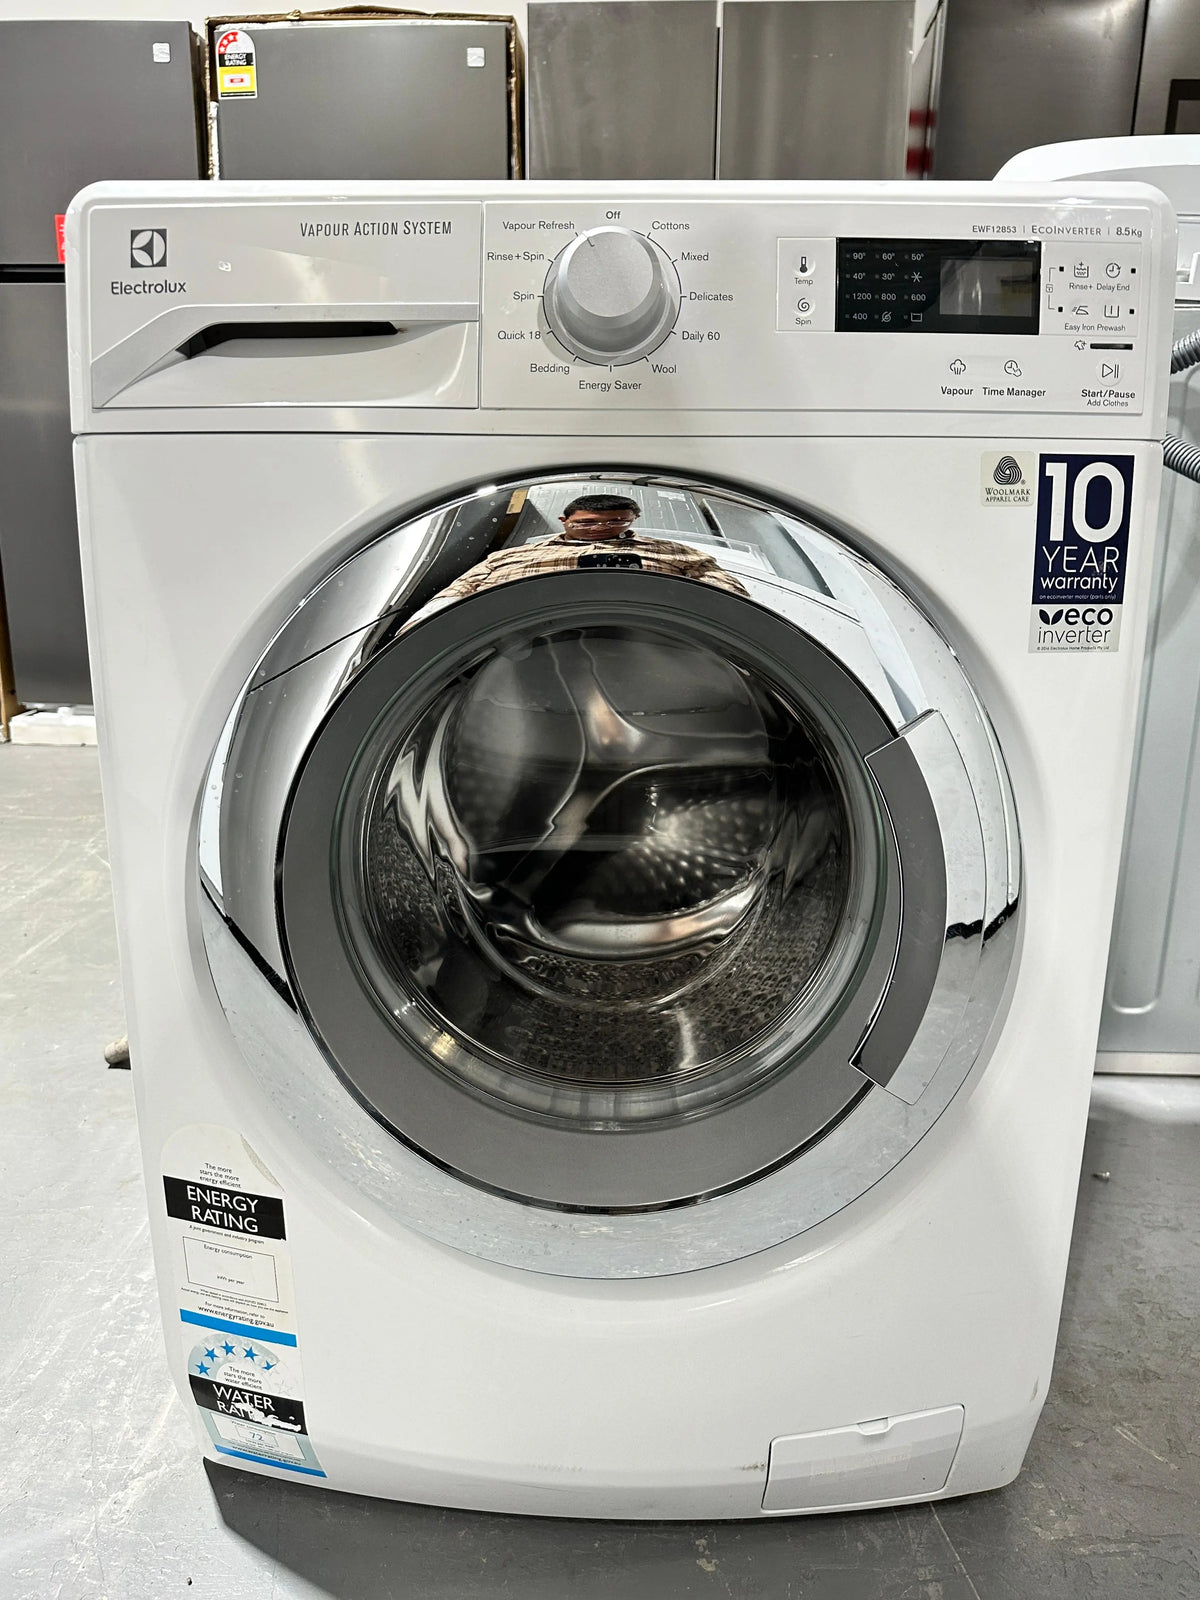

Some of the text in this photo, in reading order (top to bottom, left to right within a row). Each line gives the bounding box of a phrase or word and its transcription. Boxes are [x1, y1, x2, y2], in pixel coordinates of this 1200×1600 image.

[606, 211, 620, 220] Off
[300, 220, 452, 236] VAPOUR ACTION SYSTEM
[502, 221, 575, 232] Vapour Refresh
[652, 221, 690, 230] Cottons
[972, 225, 1017, 233] EWF12853
[1116, 226, 1142, 238] 8.5Kg
[681, 252, 709, 261] Mixed
[110, 280, 186, 295] Electrolux
[794, 278, 814, 286] Temp
[1068, 282, 1093, 290] Rinse+
[1096, 283, 1116, 291] Delay
[513, 292, 535, 301] Spin
[689, 292, 734, 301] Delicates
[882, 293, 896, 301] 800
[911, 294, 926, 302] 600
[796, 318, 812, 326] Spin
[1064, 323, 1080, 332] Easy
[1082, 323, 1095, 331] Iron
[498, 331, 541, 340] Quick 18
[682, 331, 720, 342] Daily 60
[530, 364, 570, 375] Bedding
[652, 364, 677, 374] Wool
[578, 381, 642, 392] Energy Saver
[941, 386, 974, 397] Vapour
[982, 387, 1046, 398] Time Manager
[1082, 389, 1136, 398] Start/Pause
[985, 488, 1031, 496] WOOLMARK
[1046, 462, 1125, 543] 10
[1042, 546, 1120, 573] YEAR
[1040, 573, 1118, 594] warranty
[1064, 608, 1113, 626] eco
[1038, 626, 1110, 643] inverter
[200, 1176, 241, 1188] energy efficient
[187, 1185, 258, 1214] ENERGY
[192, 1205, 258, 1232] RATING
[204, 1244, 252, 1259] Energy consumption
[229, 1366, 240, 1374] The
[213, 1384, 275, 1412] WATER
